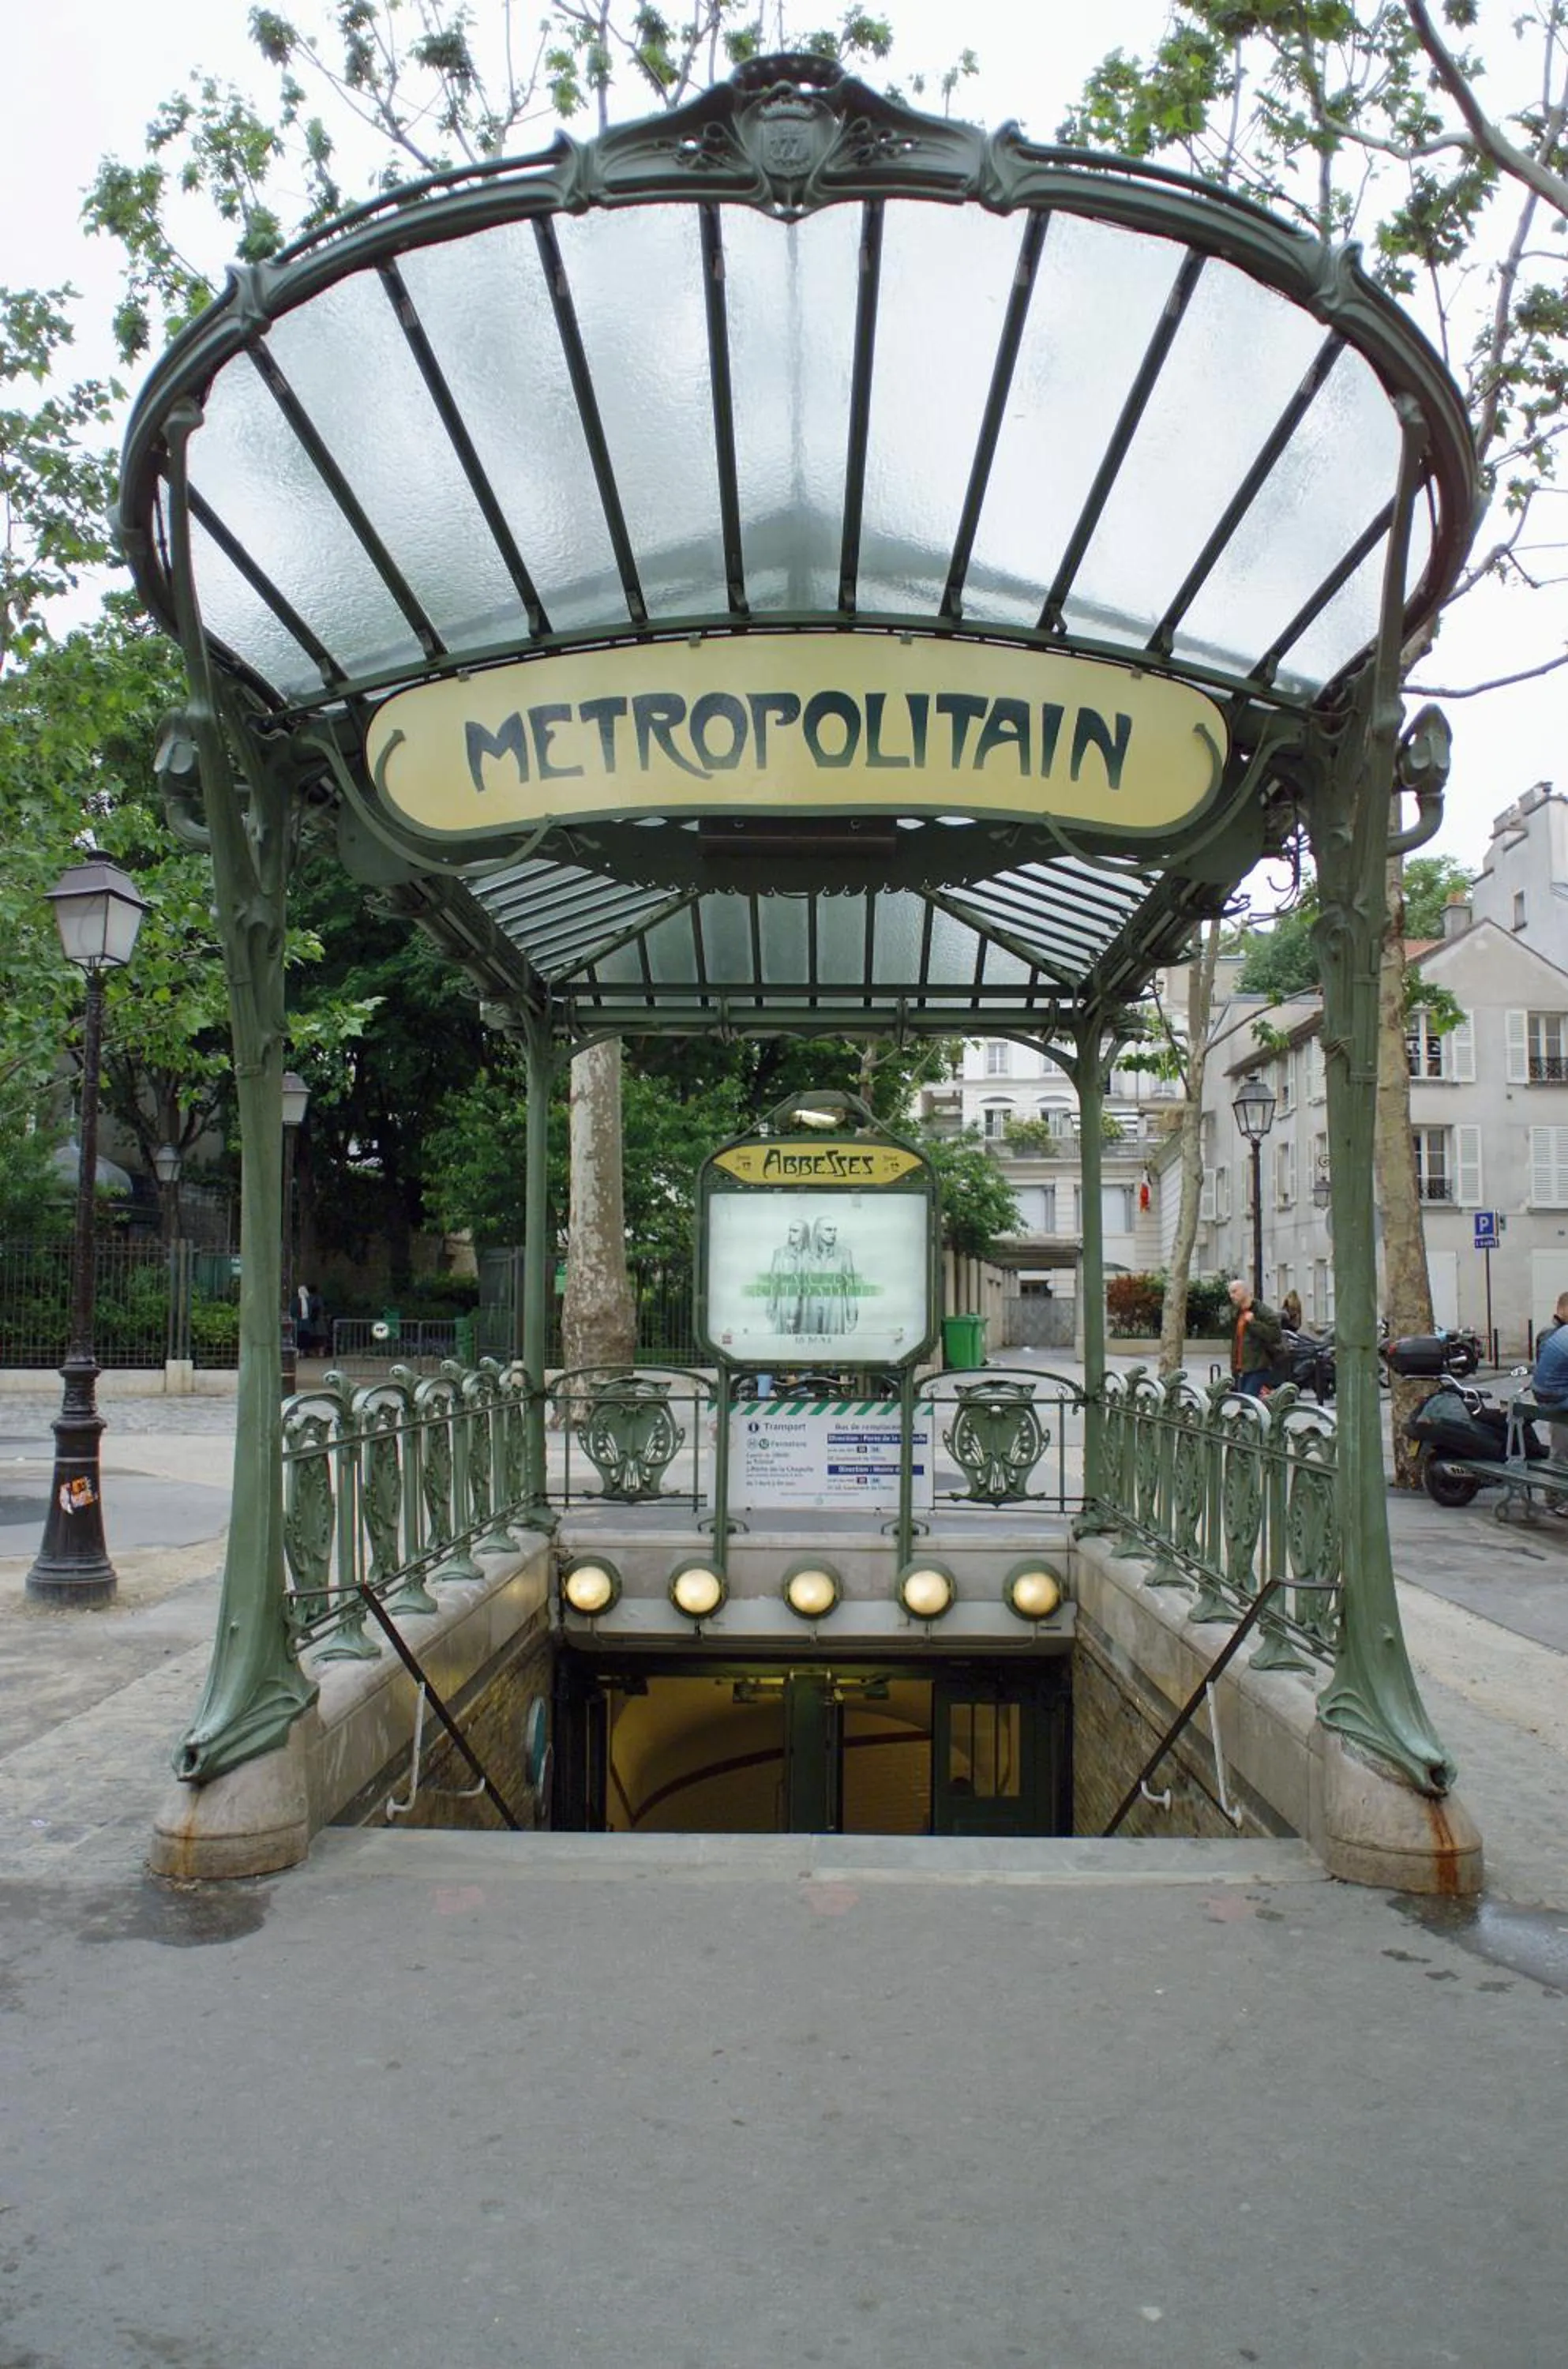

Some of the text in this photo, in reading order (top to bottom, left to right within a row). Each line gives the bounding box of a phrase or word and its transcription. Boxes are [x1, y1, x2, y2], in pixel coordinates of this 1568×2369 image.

[465, 691, 1132, 791] METROPOLITAIN
[1479, 1216, 1489, 1233] P
[764, 1423, 806, 1432] Transport
